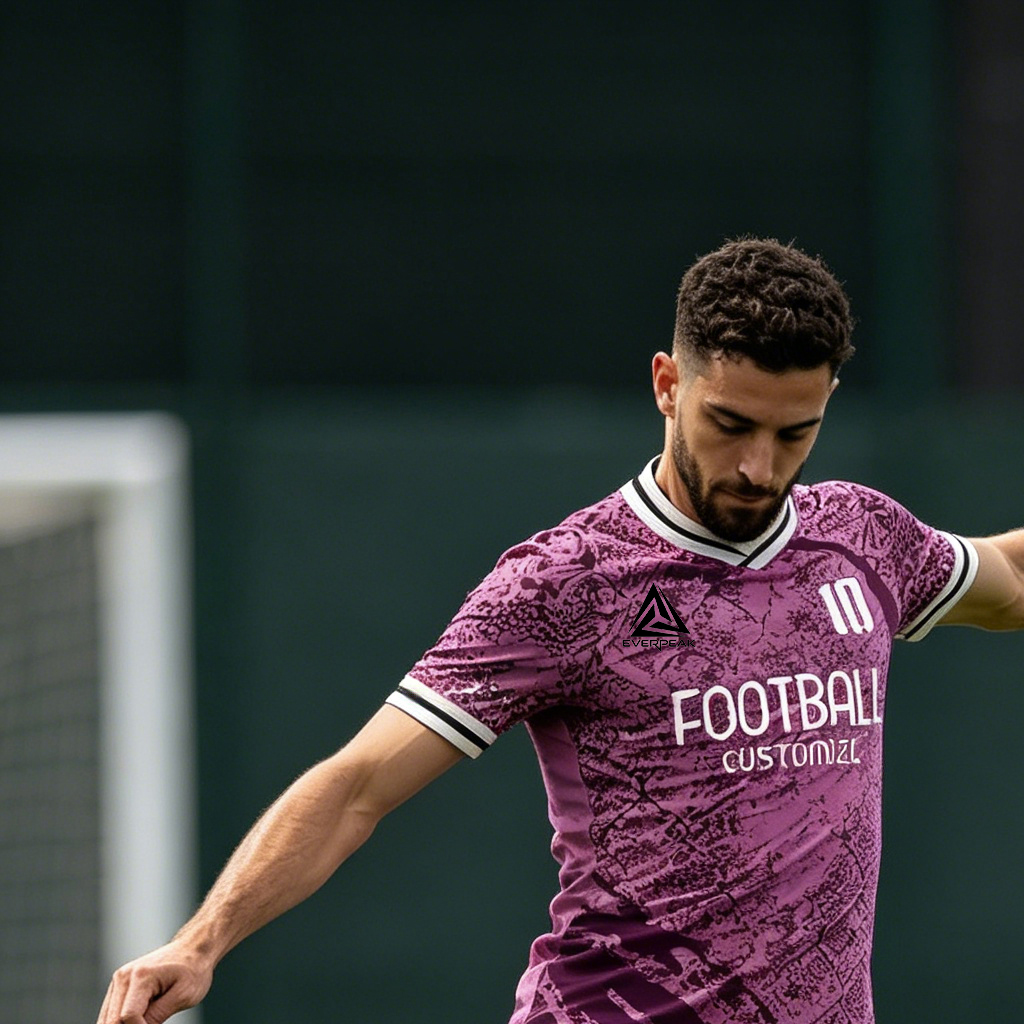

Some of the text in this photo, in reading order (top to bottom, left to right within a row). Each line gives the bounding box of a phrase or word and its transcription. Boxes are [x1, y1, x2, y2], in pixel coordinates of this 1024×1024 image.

[818, 576, 875, 635] 10
[622, 639, 695, 651] EVERPEAK
[671, 668, 882, 745] FOOTBALL
